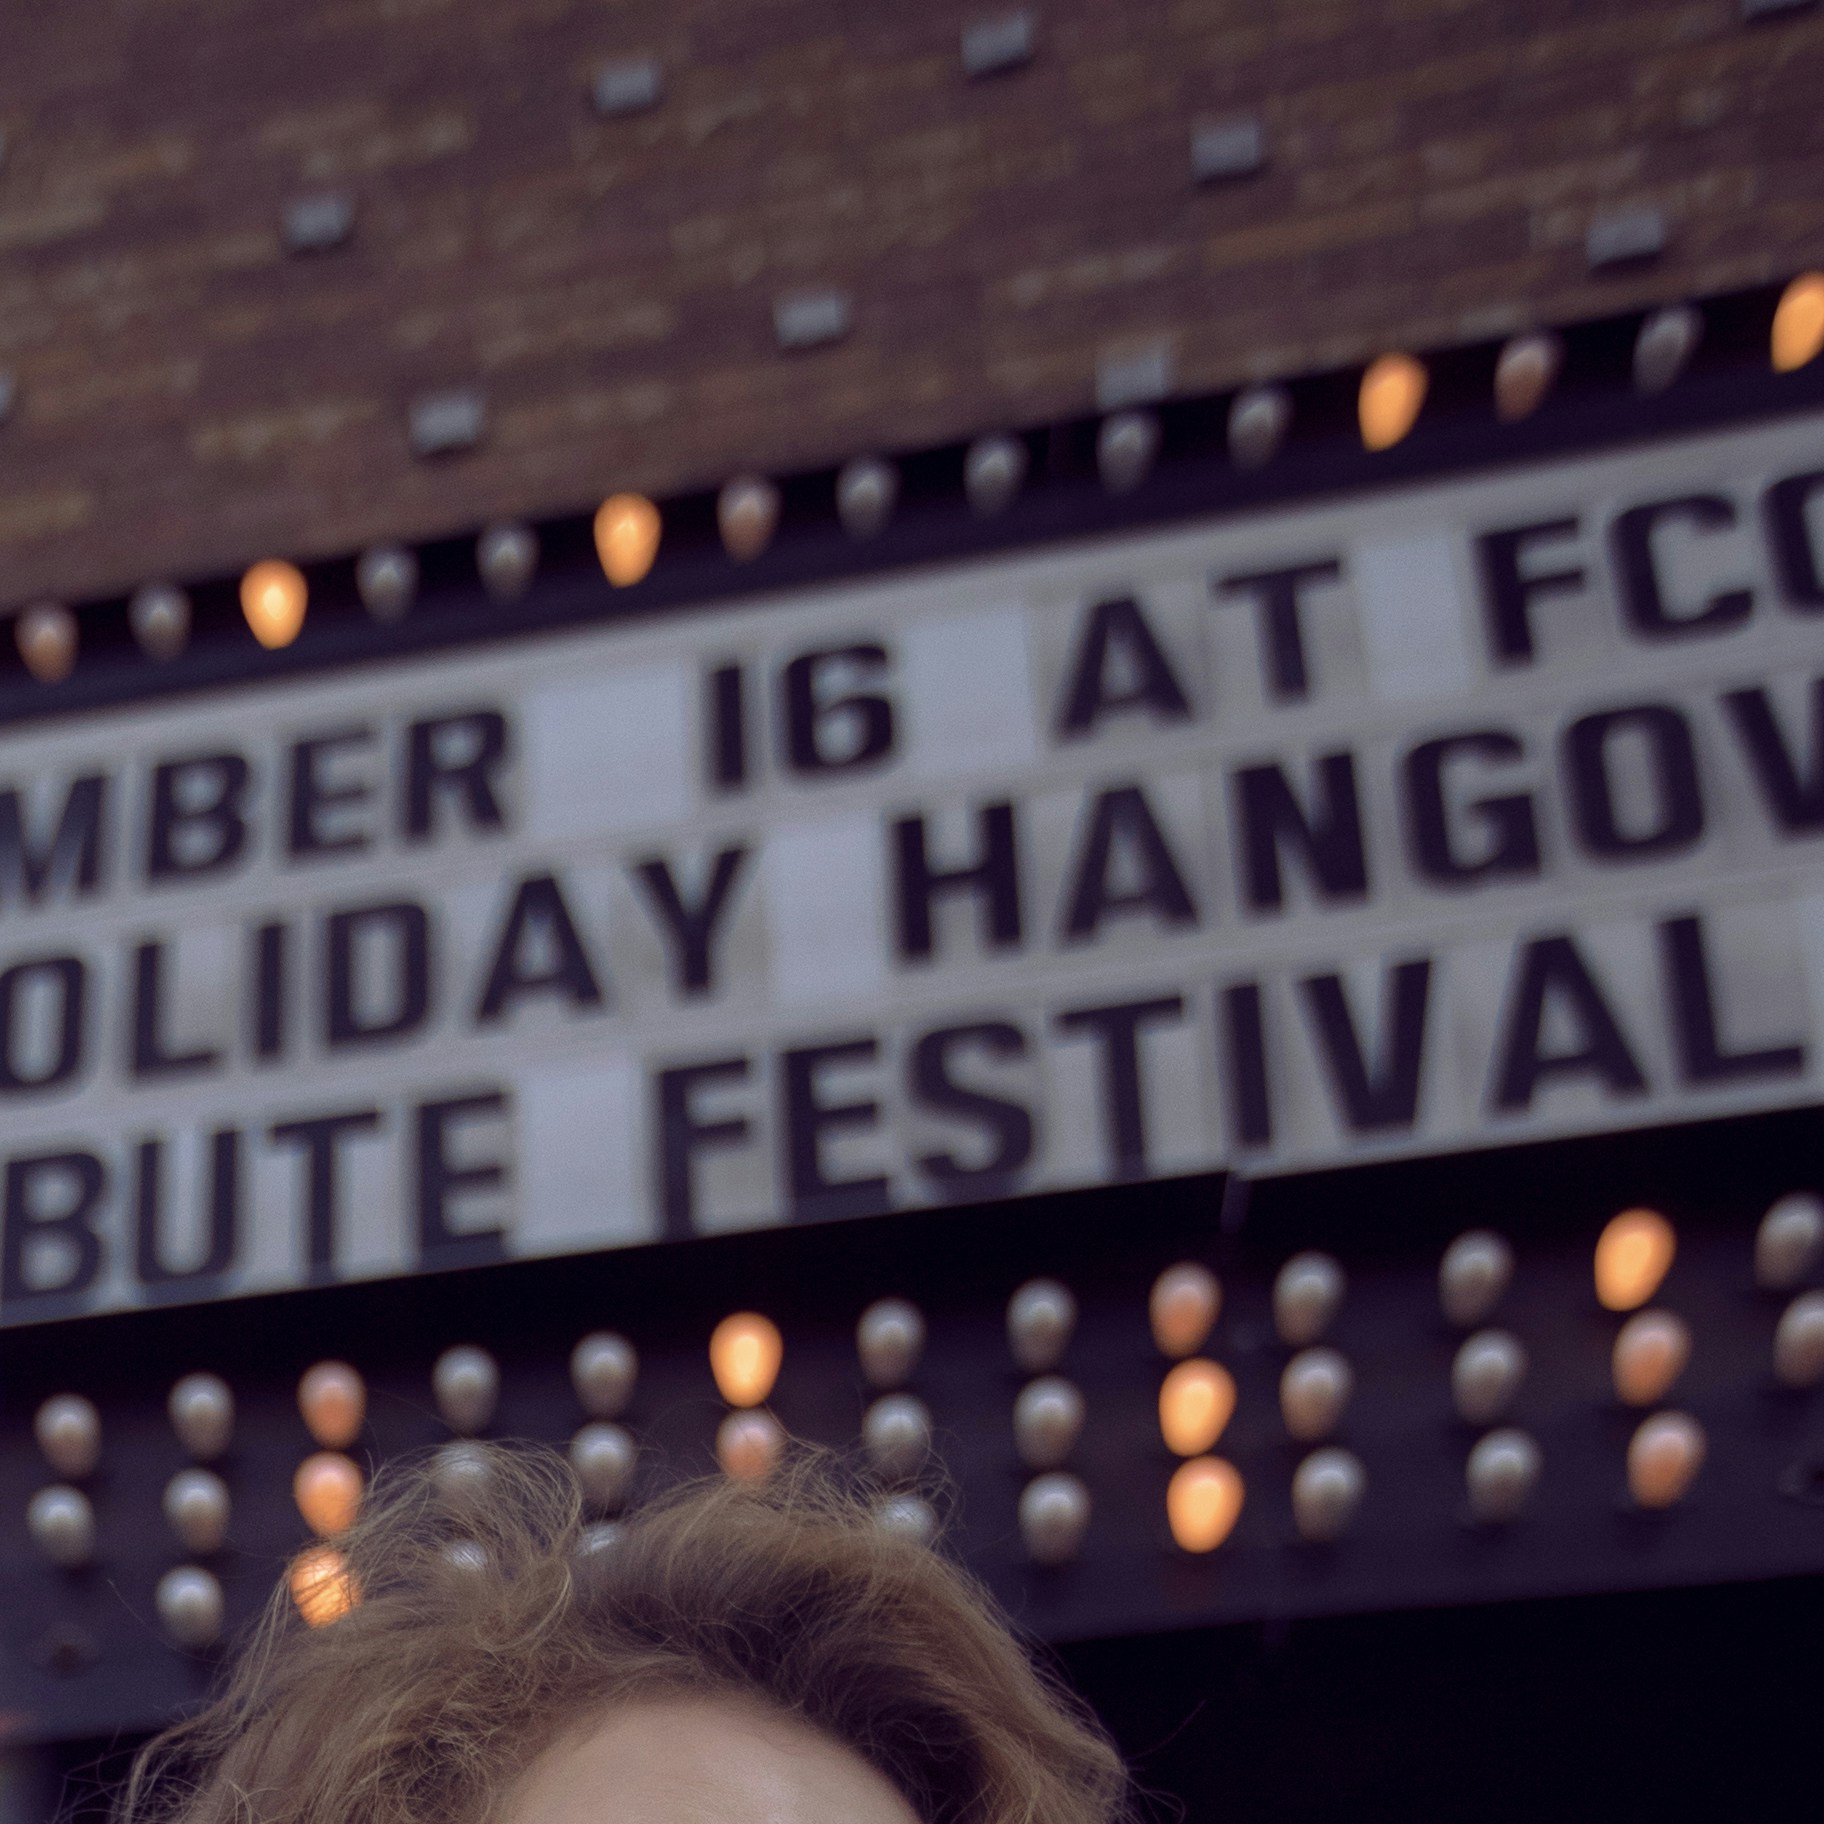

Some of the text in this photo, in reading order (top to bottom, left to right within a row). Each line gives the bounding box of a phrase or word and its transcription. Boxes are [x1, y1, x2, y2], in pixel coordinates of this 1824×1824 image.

[702, 642, 900, 795] 16
[1050, 555, 1346, 745] AT
[656, 912, 1804, 1242] FESTIVAL
